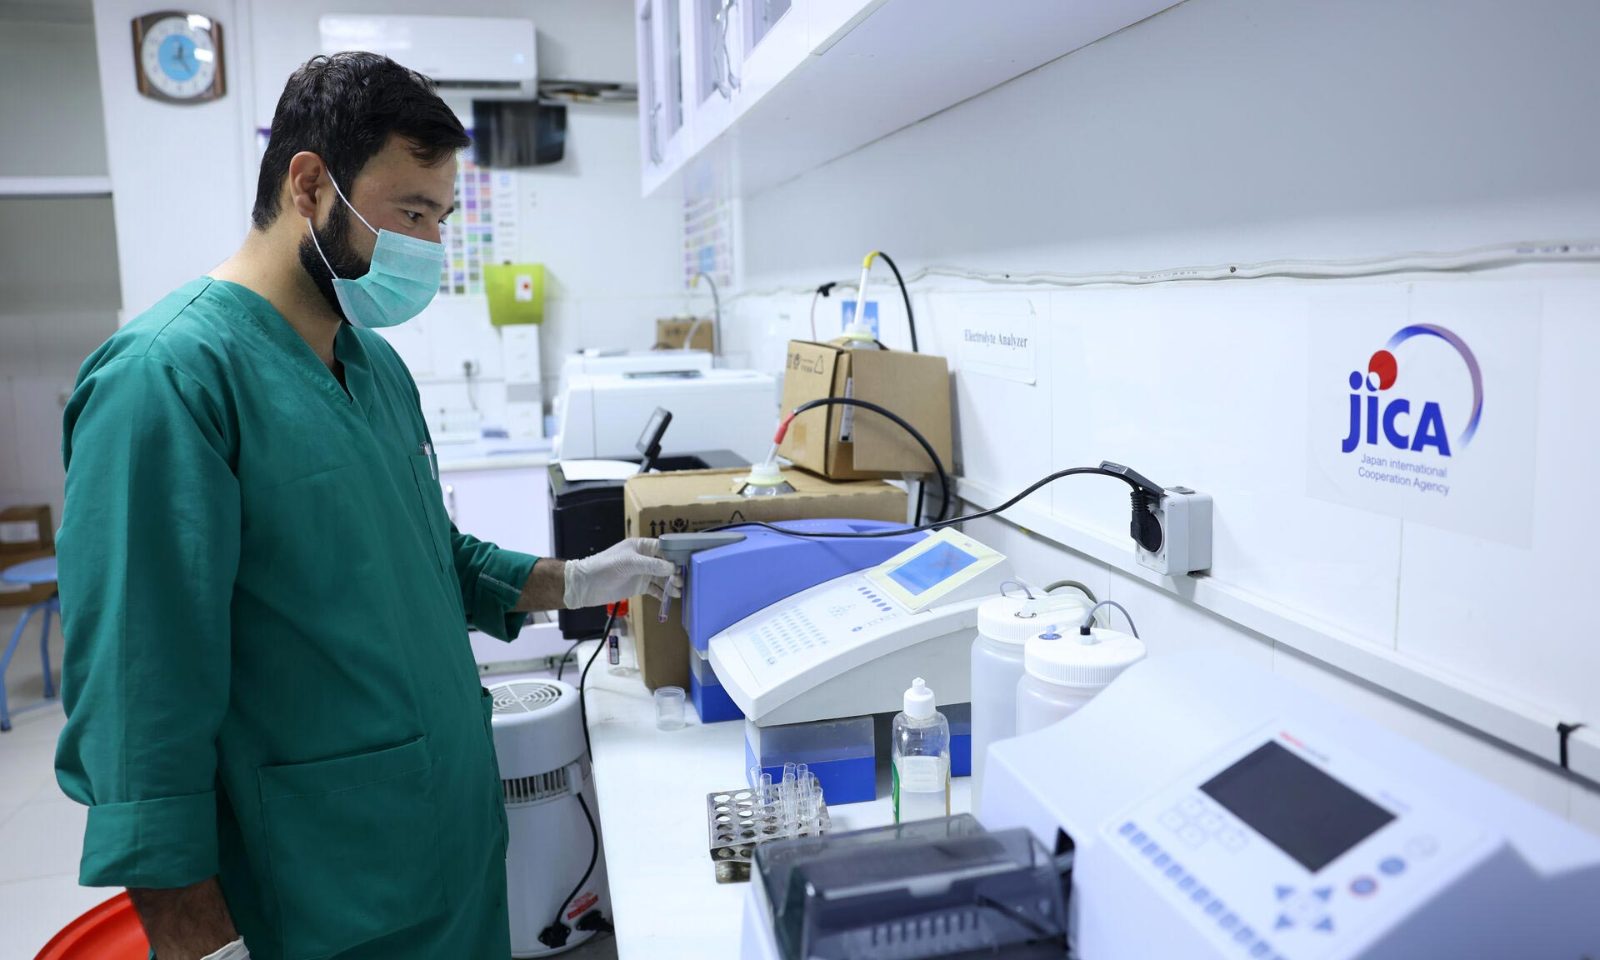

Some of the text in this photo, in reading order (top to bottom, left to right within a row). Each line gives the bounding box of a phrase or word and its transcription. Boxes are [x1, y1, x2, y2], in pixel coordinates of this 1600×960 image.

[999, 332, 1028, 351] Analyzer
[1361, 453, 1388, 467] Japan
[1358, 466, 1450, 496] Cooperation Agency
